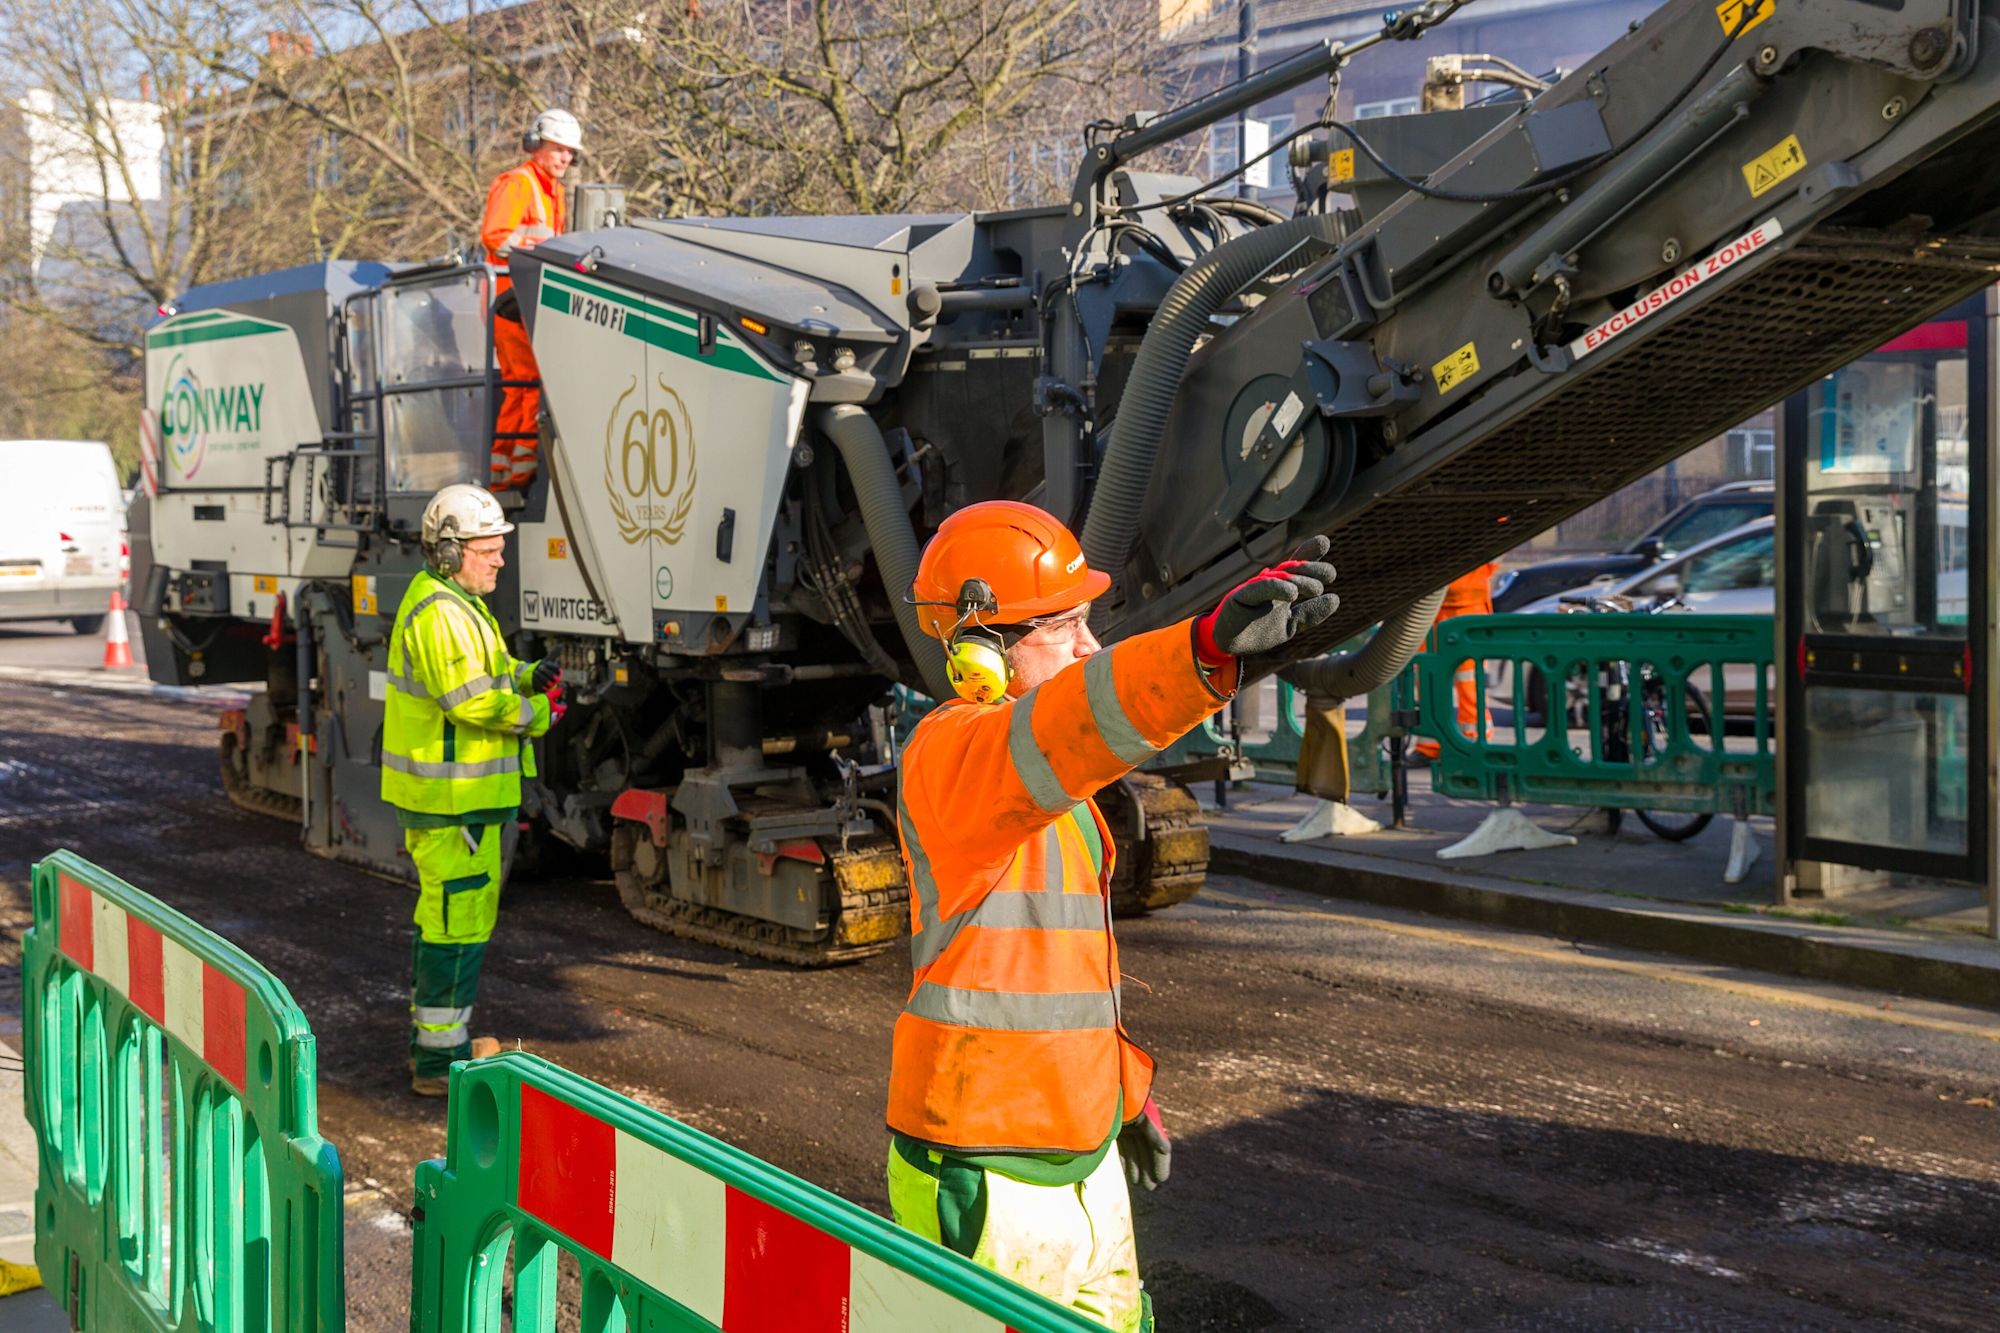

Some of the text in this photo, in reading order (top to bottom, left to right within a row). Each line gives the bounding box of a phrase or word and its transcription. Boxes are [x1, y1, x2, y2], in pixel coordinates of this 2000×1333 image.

[571, 293, 625, 332] W 210 Fi
[1584, 229, 1766, 350] EXCLUSION ZONE
[161, 383, 264, 436] CONWAY
[622, 408, 678, 498] 60
[636, 505, 666, 520] YEARS
